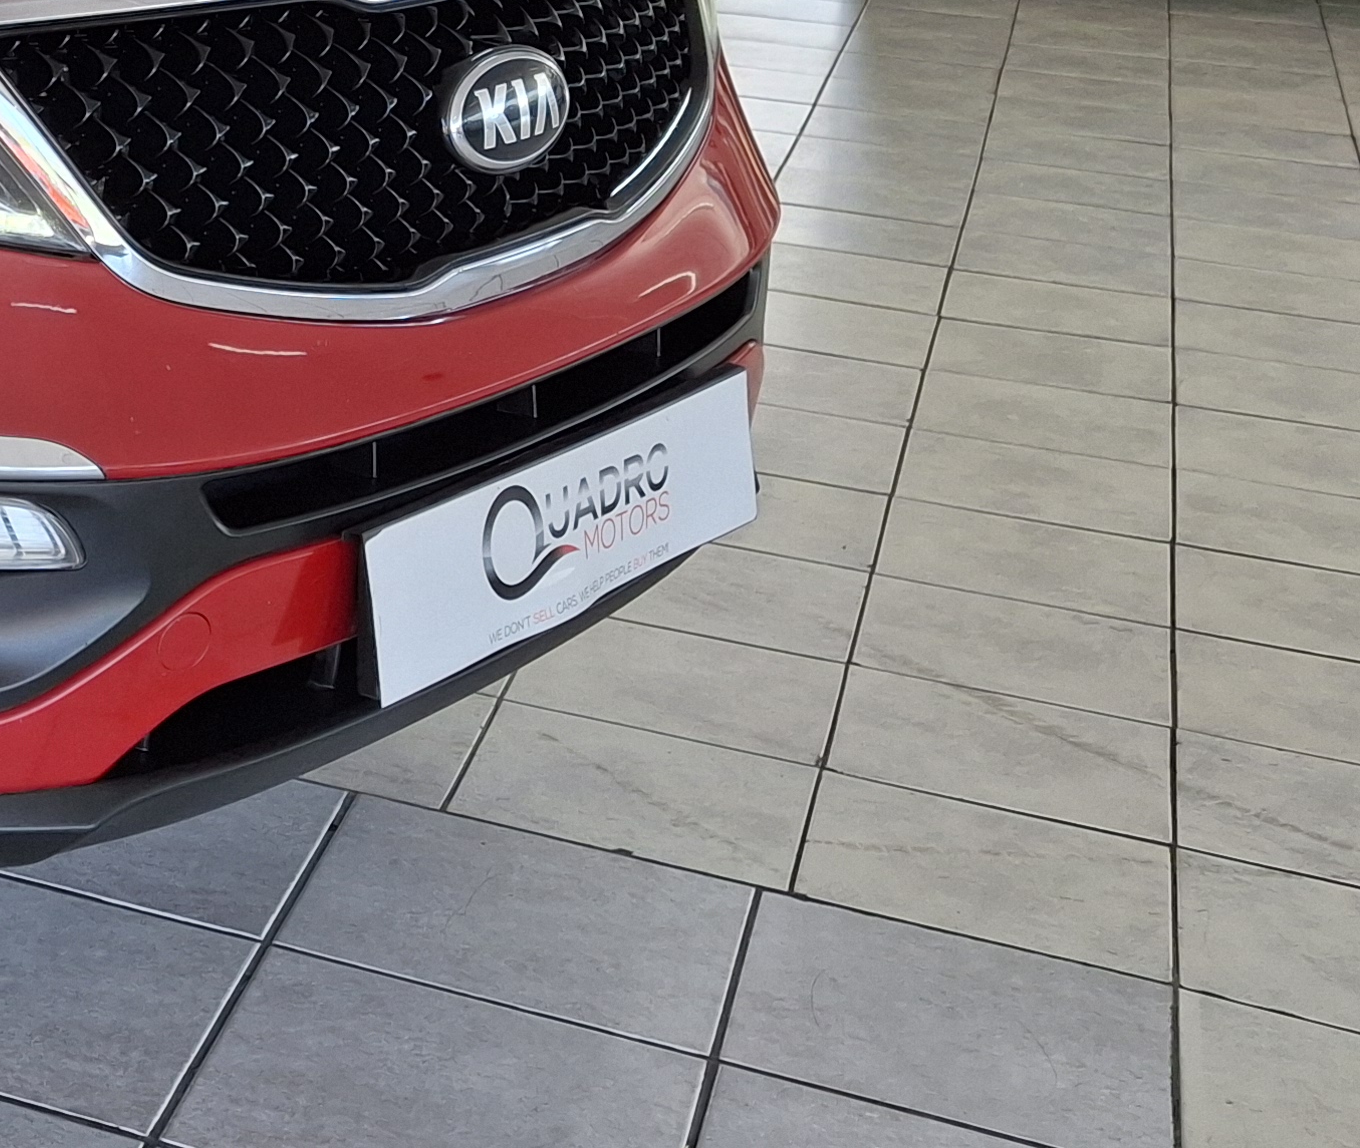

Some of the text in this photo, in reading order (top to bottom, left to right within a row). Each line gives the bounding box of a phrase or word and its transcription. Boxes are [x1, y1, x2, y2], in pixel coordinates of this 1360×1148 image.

[474, 72, 560, 150] KIA
[482, 442, 669, 600] QUADRO
[584, 490, 670, 560] MOTORS
[488, 629, 503, 645] WE
[533, 606, 555, 625] SELL
[579, 586, 590, 602] WE
[590, 575, 606, 594] HELP
[605, 561, 632, 583] PEOPLE
[633, 553, 648, 571] BUY
